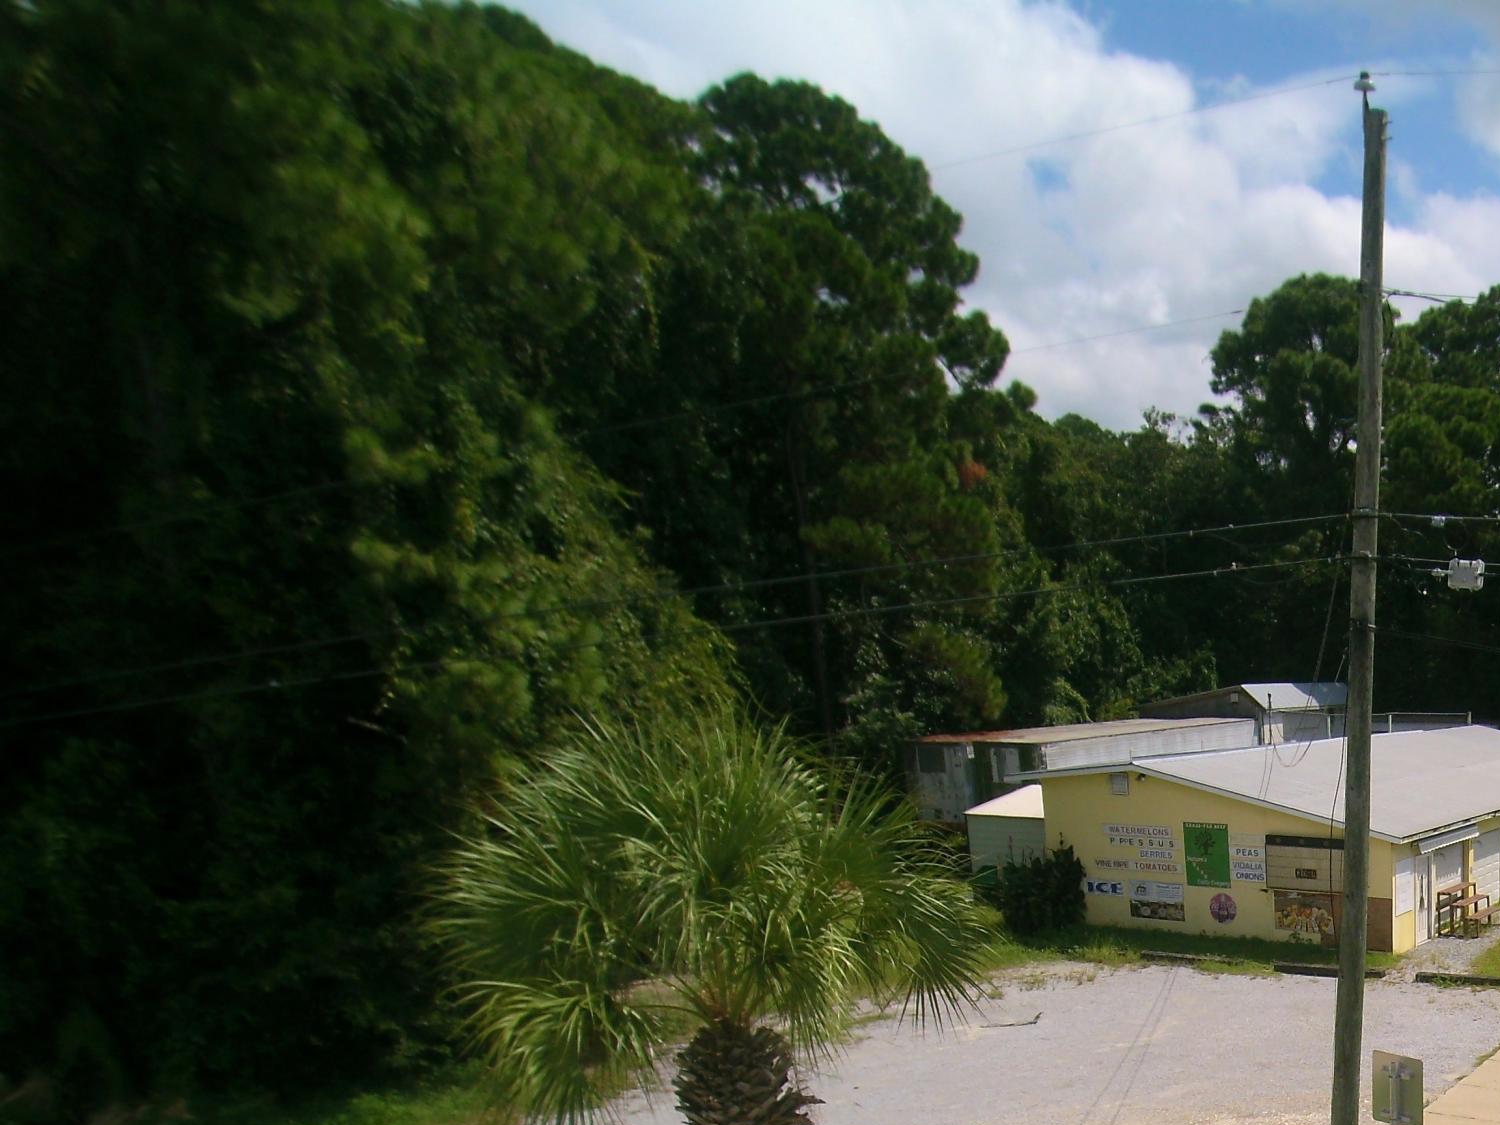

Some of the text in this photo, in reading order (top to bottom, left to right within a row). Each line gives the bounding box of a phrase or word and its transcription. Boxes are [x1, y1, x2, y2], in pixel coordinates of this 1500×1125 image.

[1108, 826, 1169, 837] WATERMELONS
[1140, 850, 1172, 860] BERRIES
[1236, 848, 1259, 857] PEAS
[1135, 862, 1178, 872] TOMATOES
[1233, 861, 1263, 871] VIDALIA
[1235, 871, 1265, 881] ONIONS
[1087, 881, 1123, 894] ICE
